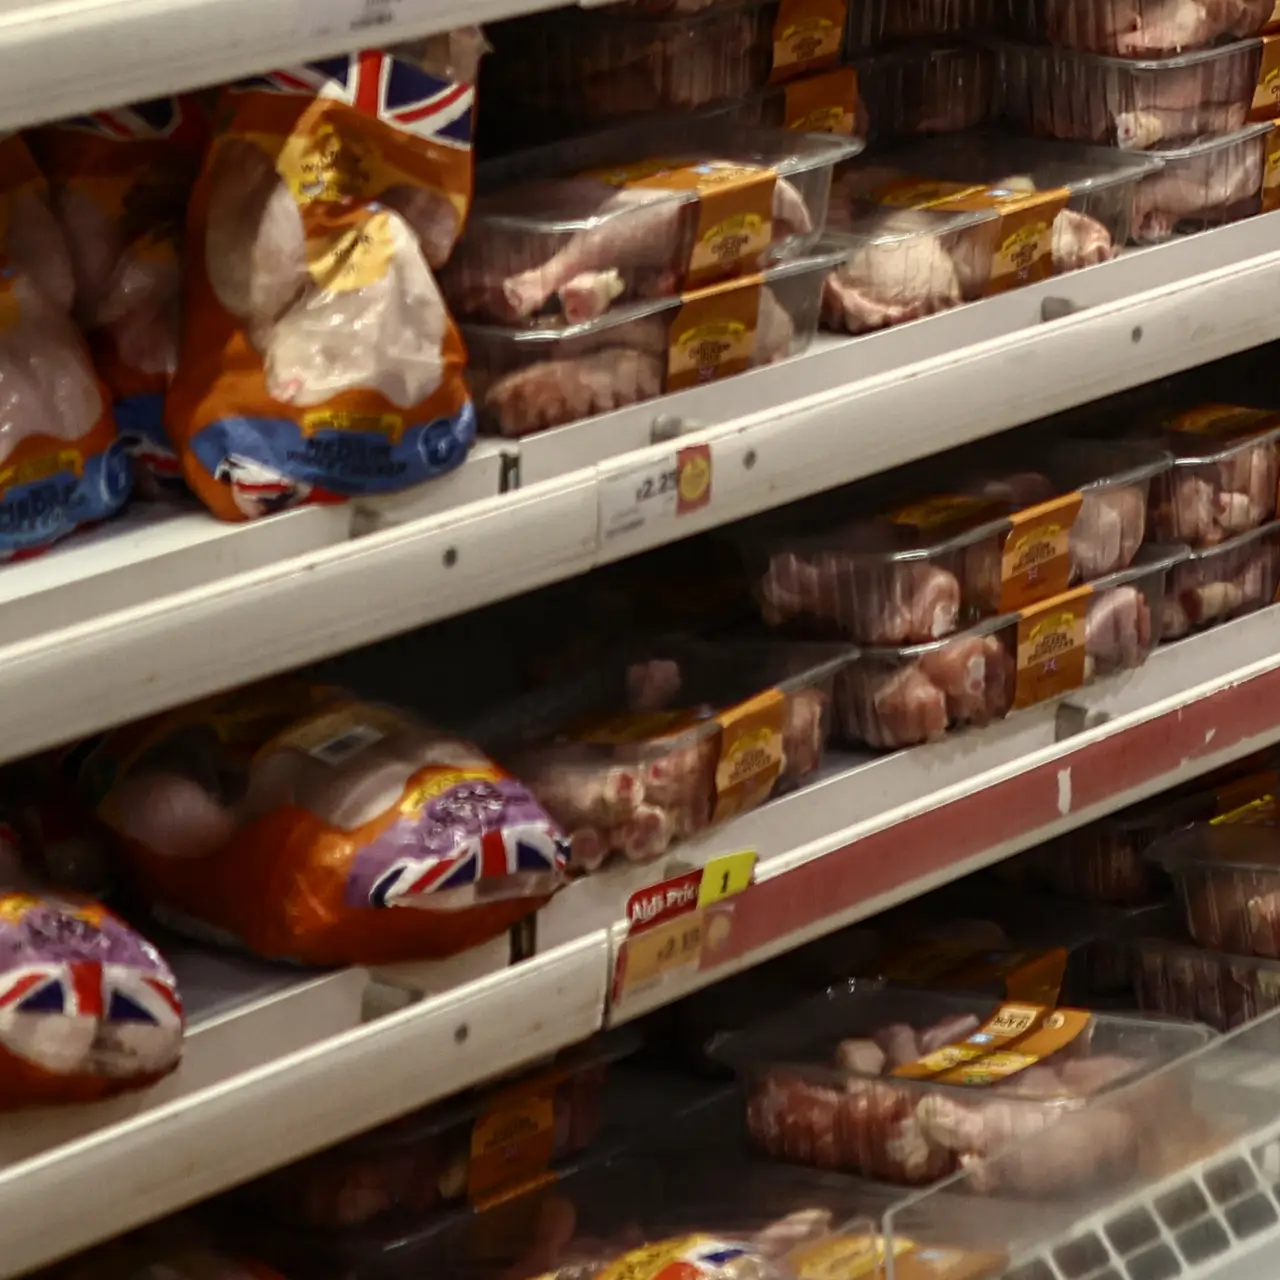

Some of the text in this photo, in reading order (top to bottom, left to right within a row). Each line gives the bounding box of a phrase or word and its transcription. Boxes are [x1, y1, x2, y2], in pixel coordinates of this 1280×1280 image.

[720, 871, 729, 894] 1
[632, 883, 698, 921] Aldi Pric
